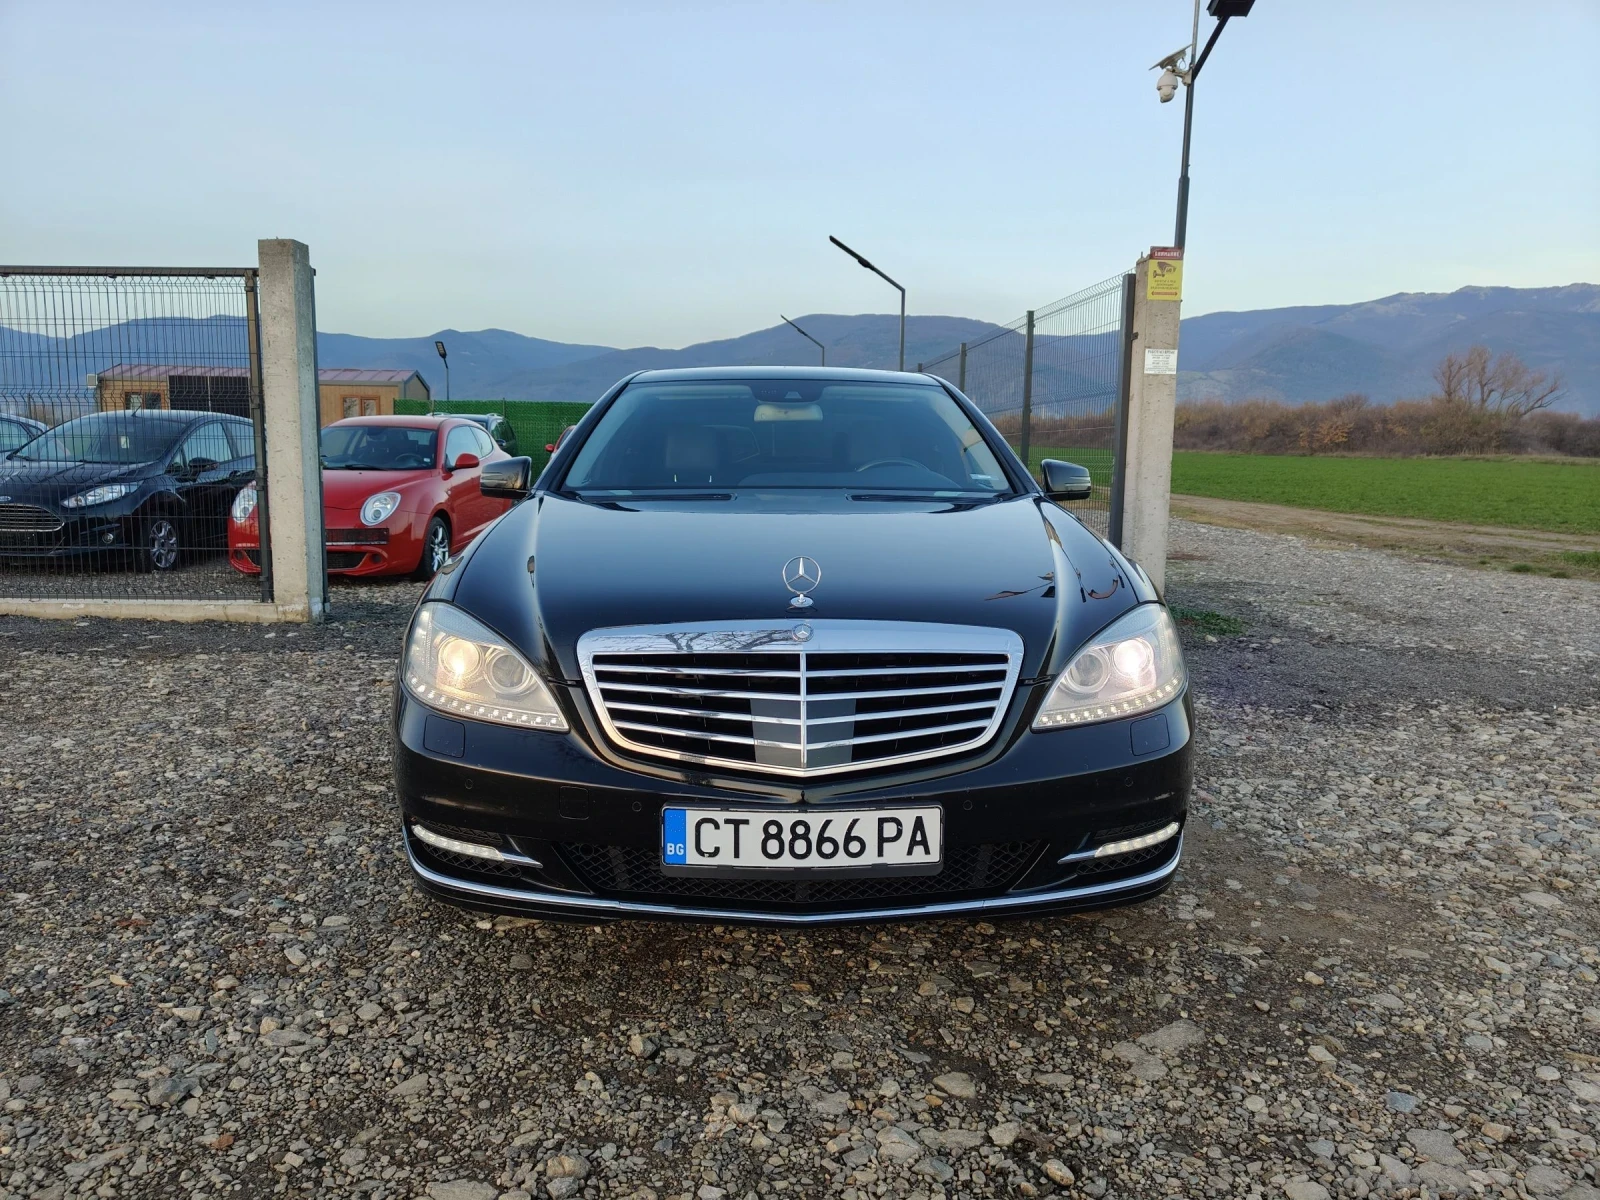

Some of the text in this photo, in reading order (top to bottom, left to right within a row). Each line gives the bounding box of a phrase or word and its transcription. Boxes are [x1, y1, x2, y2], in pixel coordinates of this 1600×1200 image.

[666, 843, 685, 856] BG
[694, 815, 931, 860] CT 8866 PA
